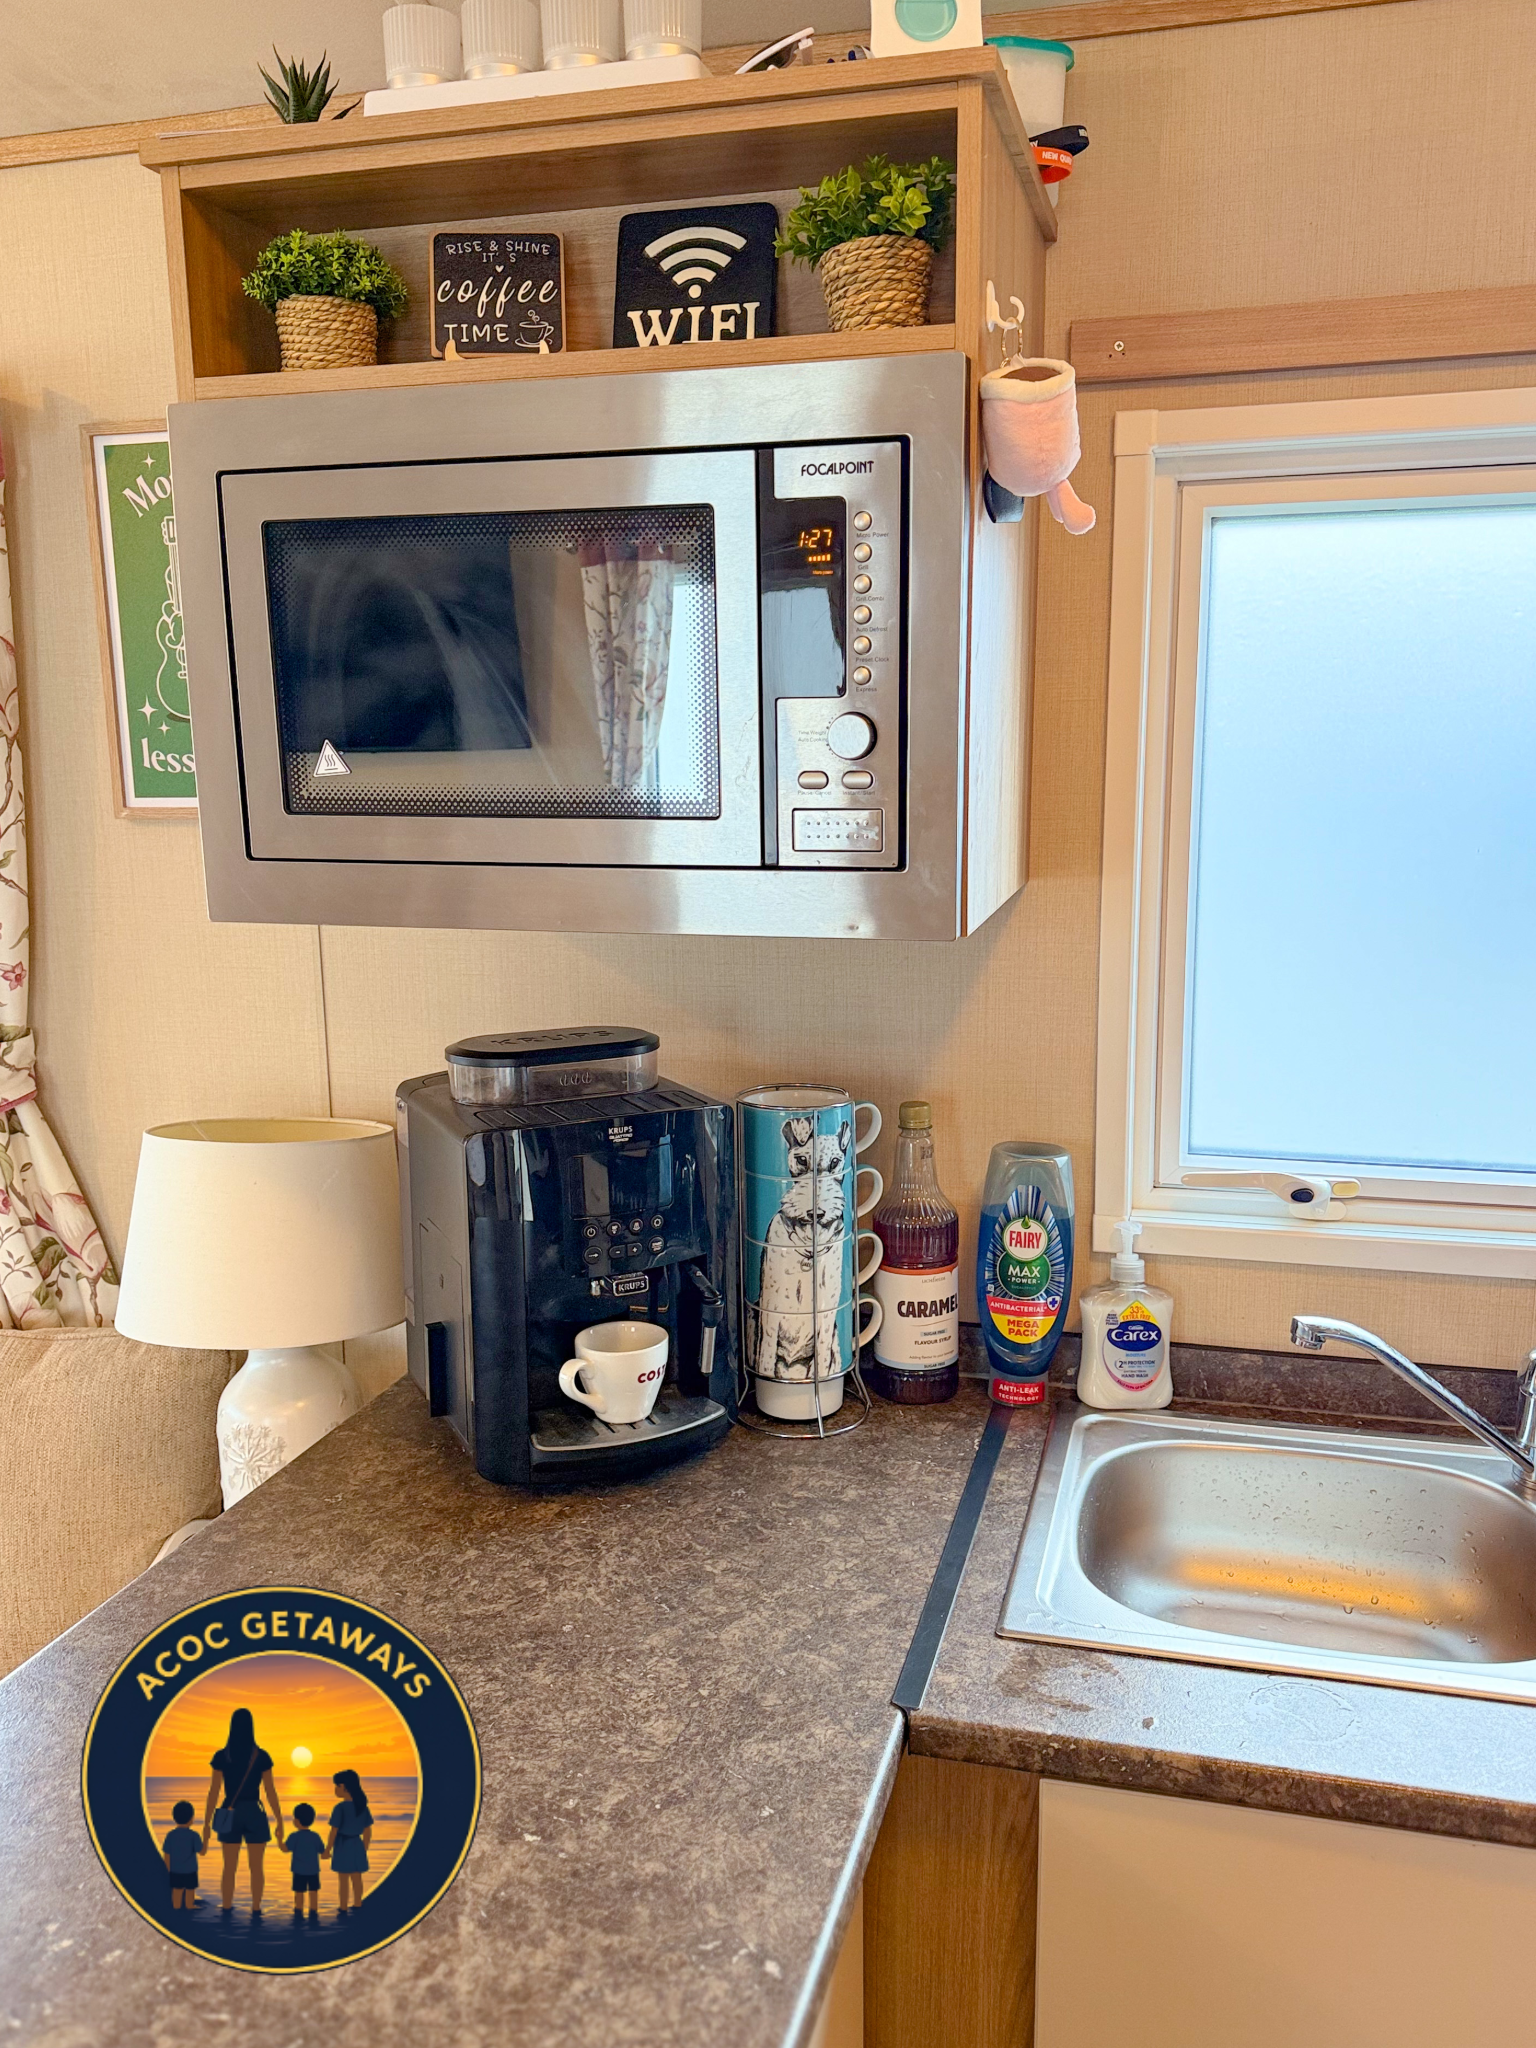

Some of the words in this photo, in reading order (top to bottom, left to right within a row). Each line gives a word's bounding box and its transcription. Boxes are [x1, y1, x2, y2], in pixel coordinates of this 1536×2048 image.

[1042, 151, 1058, 160] NEW
[446, 241, 482, 255] RISE
[490, 240, 499, 251] &
[506, 241, 550, 255] SHINE
[437, 276, 558, 318] coffee
[627, 302, 760, 347] WIFI
[444, 323, 509, 343] TIME
[801, 460, 875, 477] FOCALPOINT
[799, 528, 832, 548] 1:27
[491, 1030, 614, 1046] KRUPS
[608, 1125, 633, 1135] KRUPS
[1009, 1230, 1042, 1249] FAIRY
[1008, 1264, 1040, 1277] MAX
[618, 1280, 645, 1292] KRUPS
[897, 1293, 958, 1318] CARAMEL
[1007, 1319, 1039, 1328] MEGA
[1008, 1328, 1037, 1337] PACK
[1111, 1329, 1159, 1342] Carex
[999, 1383, 1039, 1394] ANTI-LEAK
[998, 1392, 1039, 1402] TECHNOLOGY
